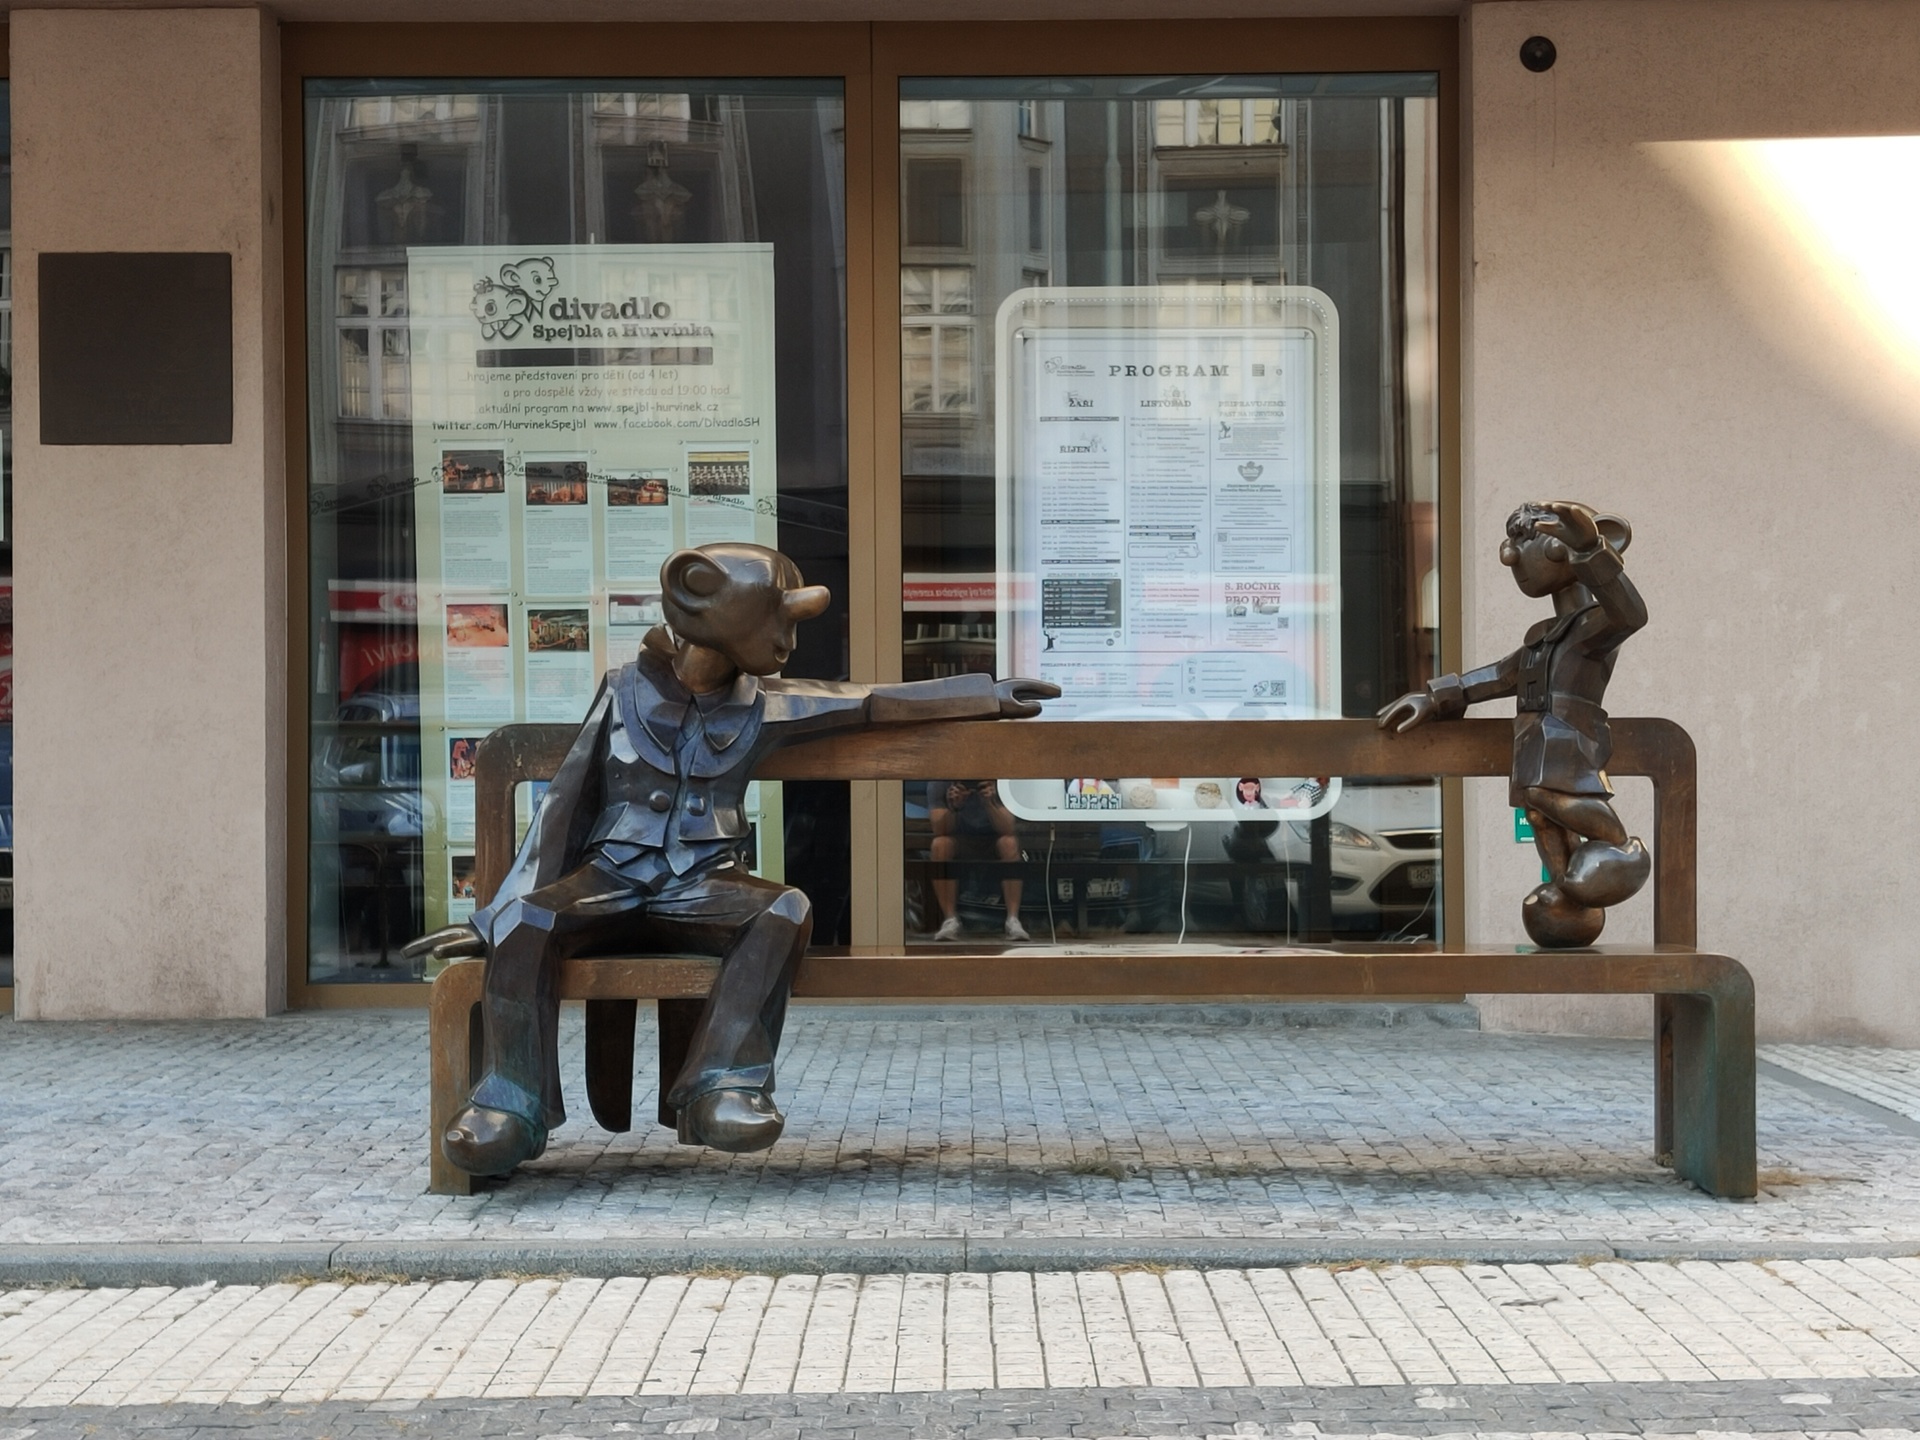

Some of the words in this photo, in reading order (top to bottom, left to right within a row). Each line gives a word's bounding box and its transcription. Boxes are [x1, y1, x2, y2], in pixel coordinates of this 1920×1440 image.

[549, 297, 671, 321] divadlo
[532, 324, 603, 341] Spejbla
[606, 327, 619, 338] a
[621, 323, 714, 338] Hurvínka
[514, 370, 578, 383] představení
[581, 372, 599, 382] pro
[602, 369, 625, 380] děti
[628, 369, 645, 381] (od
[648, 369, 655, 379] 4
[658, 369, 679, 381] let)
[1108, 365, 1229, 377] PROGRAM
[513, 389, 531, 399] pro
[534, 387, 575, 399] dospělé
[607, 388, 618, 396] ve
[622, 386, 657, 396] středu
[660, 386, 673, 396] od
[677, 385, 707, 396] 19:00
[711, 385, 730, 395] hod
[524, 404, 568, 416] program
[572, 405, 584, 413] na
[587, 402, 719, 415] www.spejbl-hurvinek.cz
[432, 419, 587, 431] twitter.com/HurvinekSpejbl
[593, 417, 760, 429] www.facebook.com/DivadloSH
